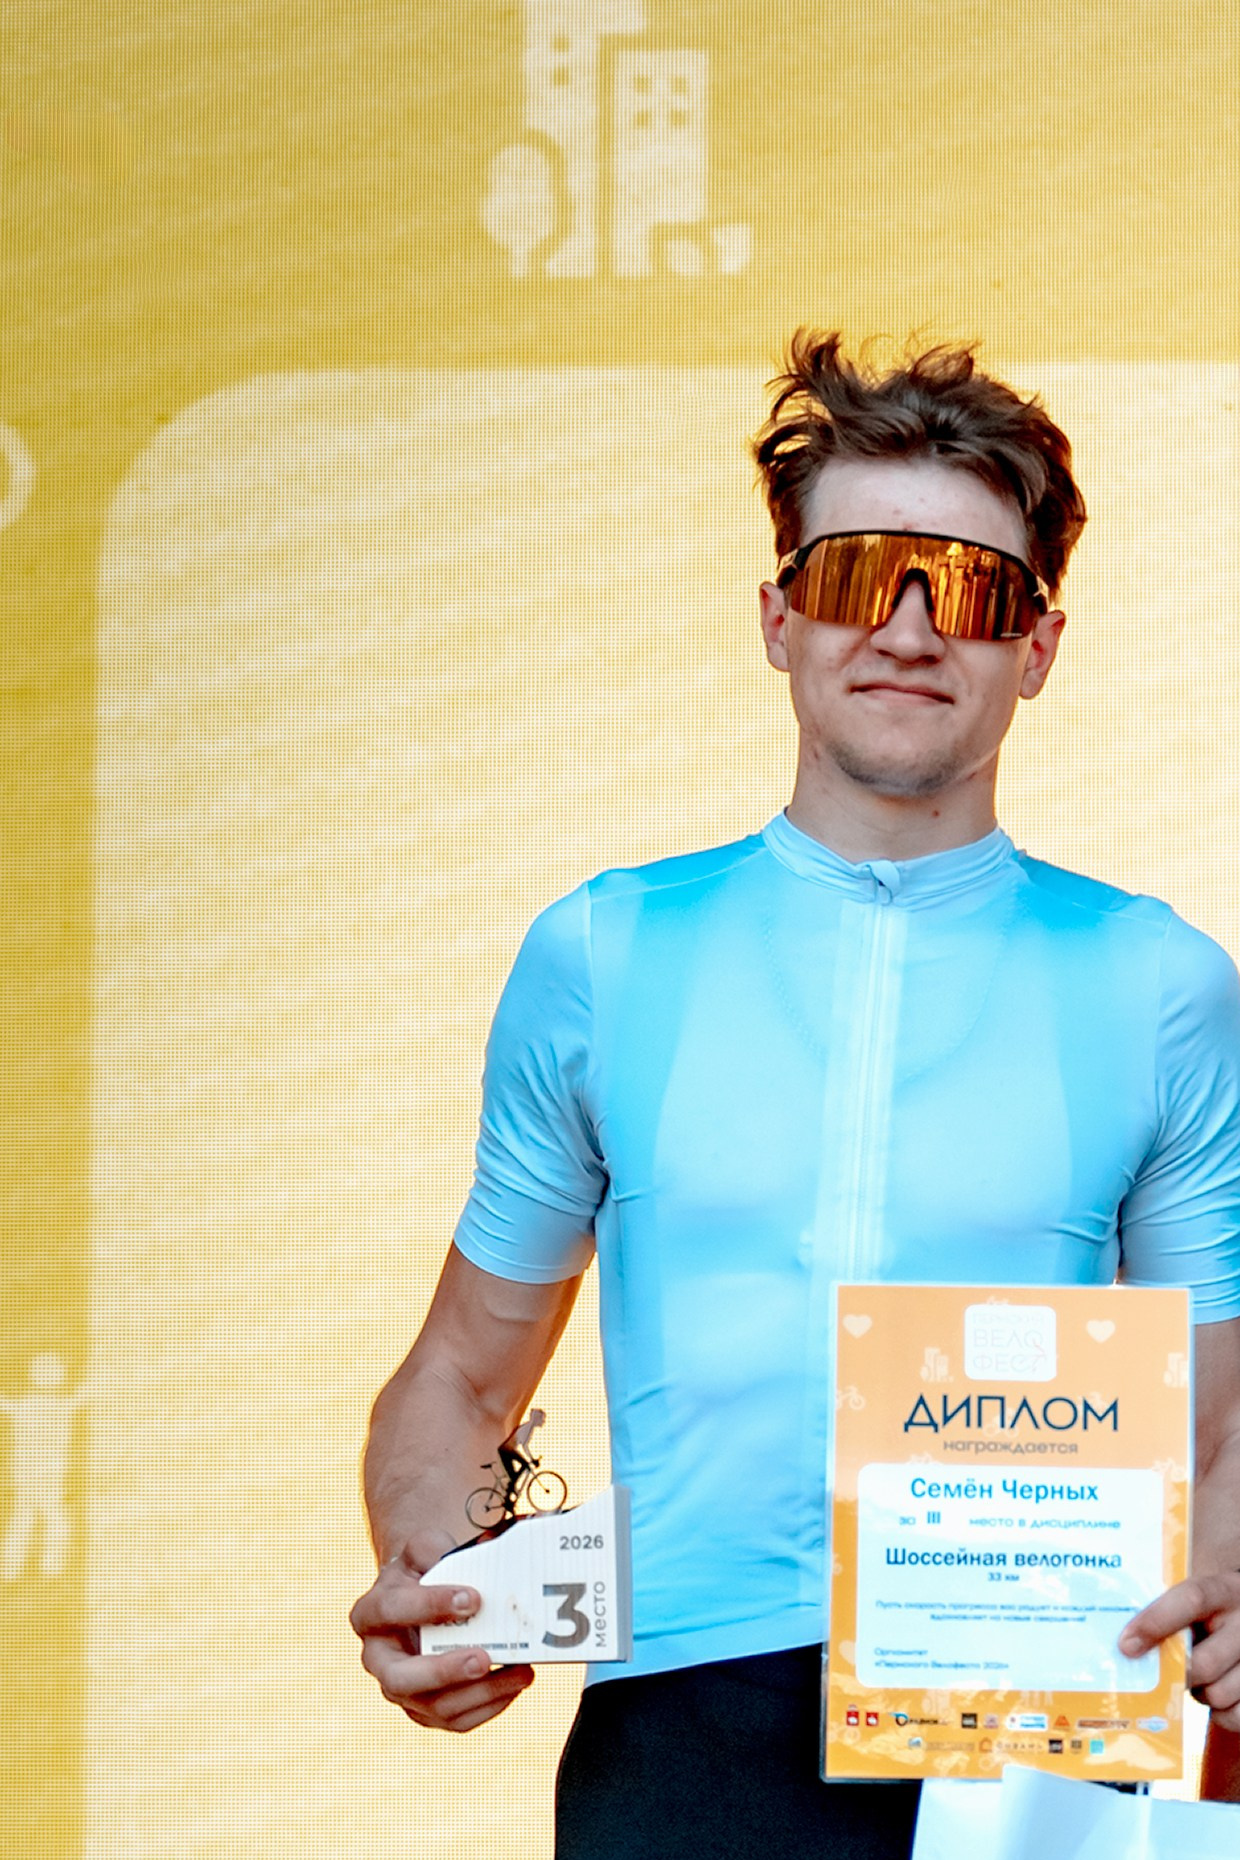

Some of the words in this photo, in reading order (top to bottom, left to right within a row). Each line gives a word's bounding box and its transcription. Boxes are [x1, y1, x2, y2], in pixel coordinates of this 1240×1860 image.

[904, 1393, 1120, 1433] ДИПЛОМ
[943, 1439, 1078, 1455] награждается
[910, 1477, 993, 1500] Семён
[1001, 1479, 1099, 1504] Черных
[969, 1517, 1014, 1528] место
[1018, 1518, 1026, 1527] в
[1030, 1518, 1121, 1531] дисциплине
[559, 1534, 604, 1550] 2026
[885, 1547, 1007, 1567] Шоссейная
[1015, 1551, 1122, 1569] велогонка
[542, 1582, 591, 1649] 3
